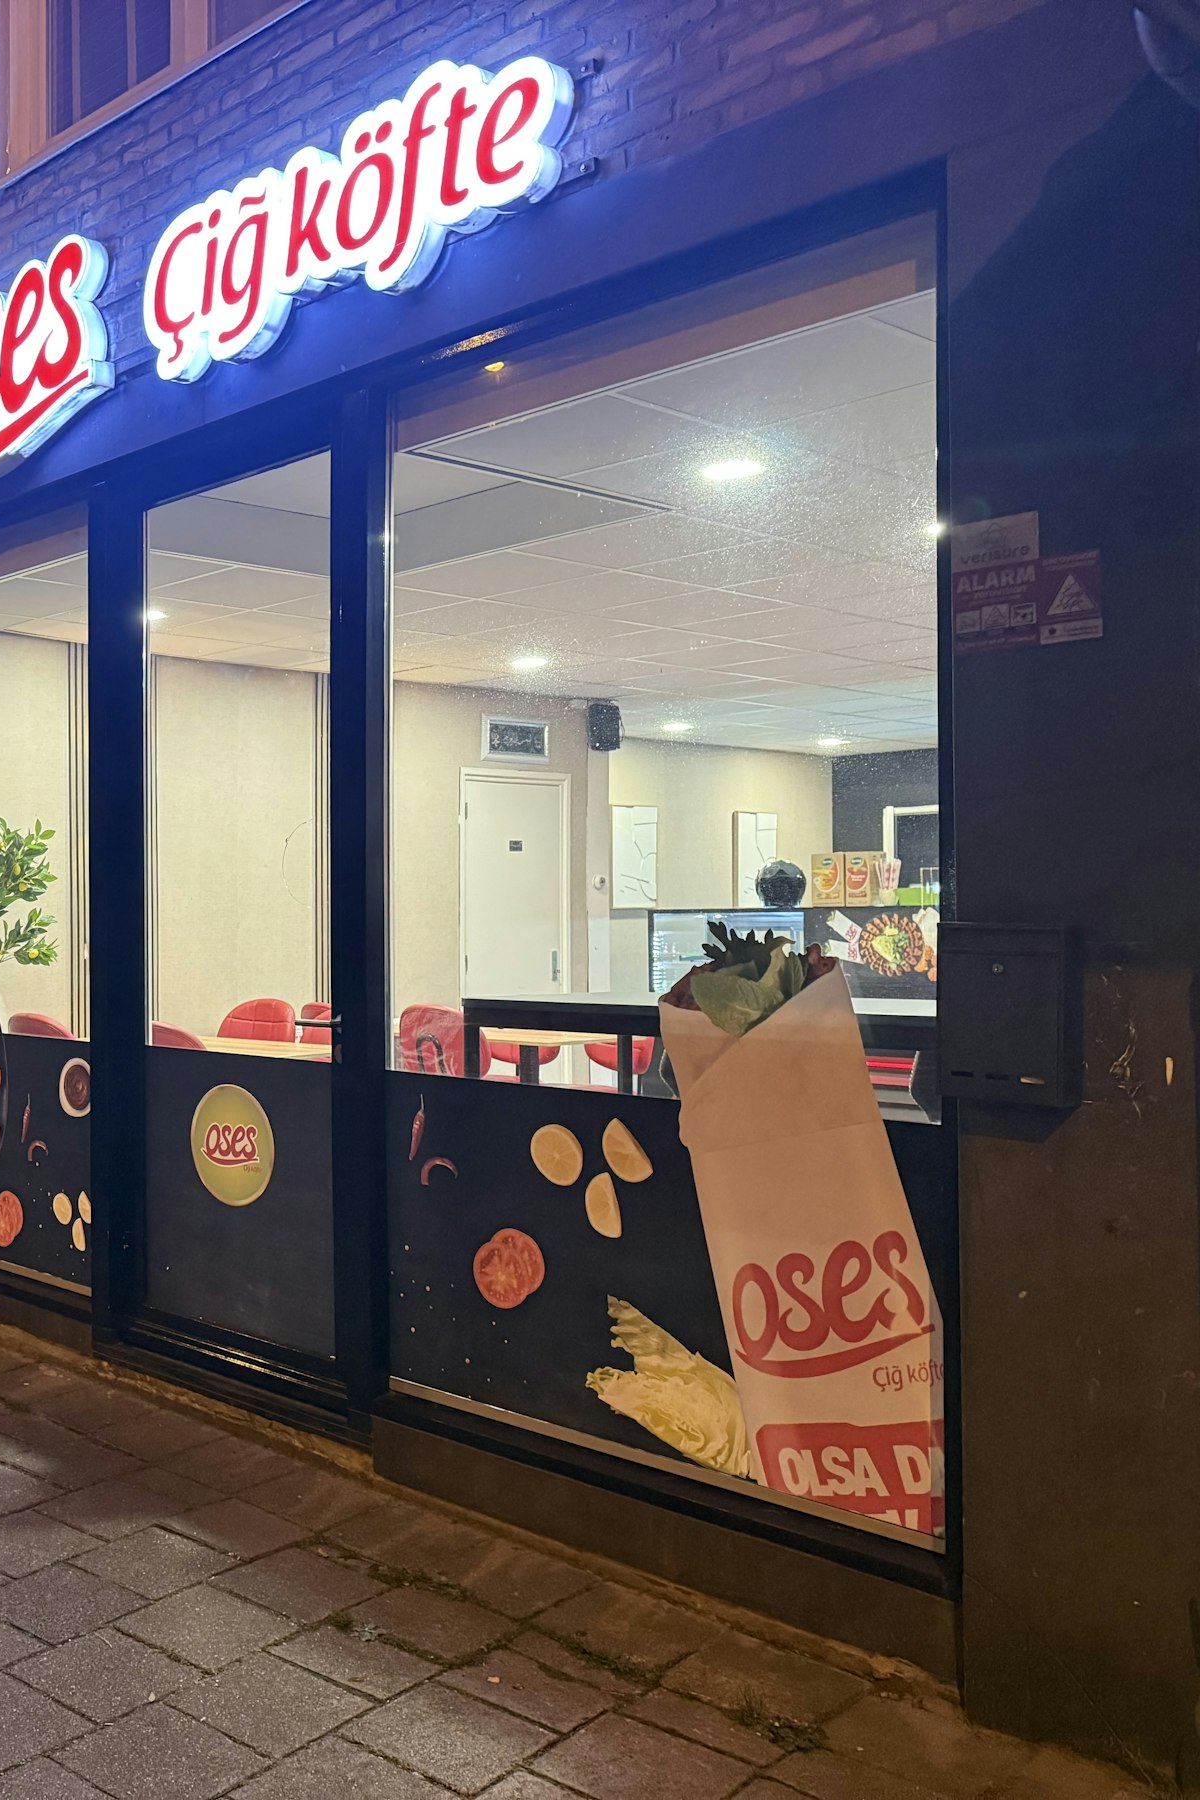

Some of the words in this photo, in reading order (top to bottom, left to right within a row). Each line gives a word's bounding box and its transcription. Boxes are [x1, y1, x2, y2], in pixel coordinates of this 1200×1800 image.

[286, 77, 540, 278] köfte
[960, 544, 1031, 565] verisure
[956, 564, 1036, 594] ALARM
[872, 1365, 903, 1392] Çiğ
[778, 1445, 890, 1498] OLSA
